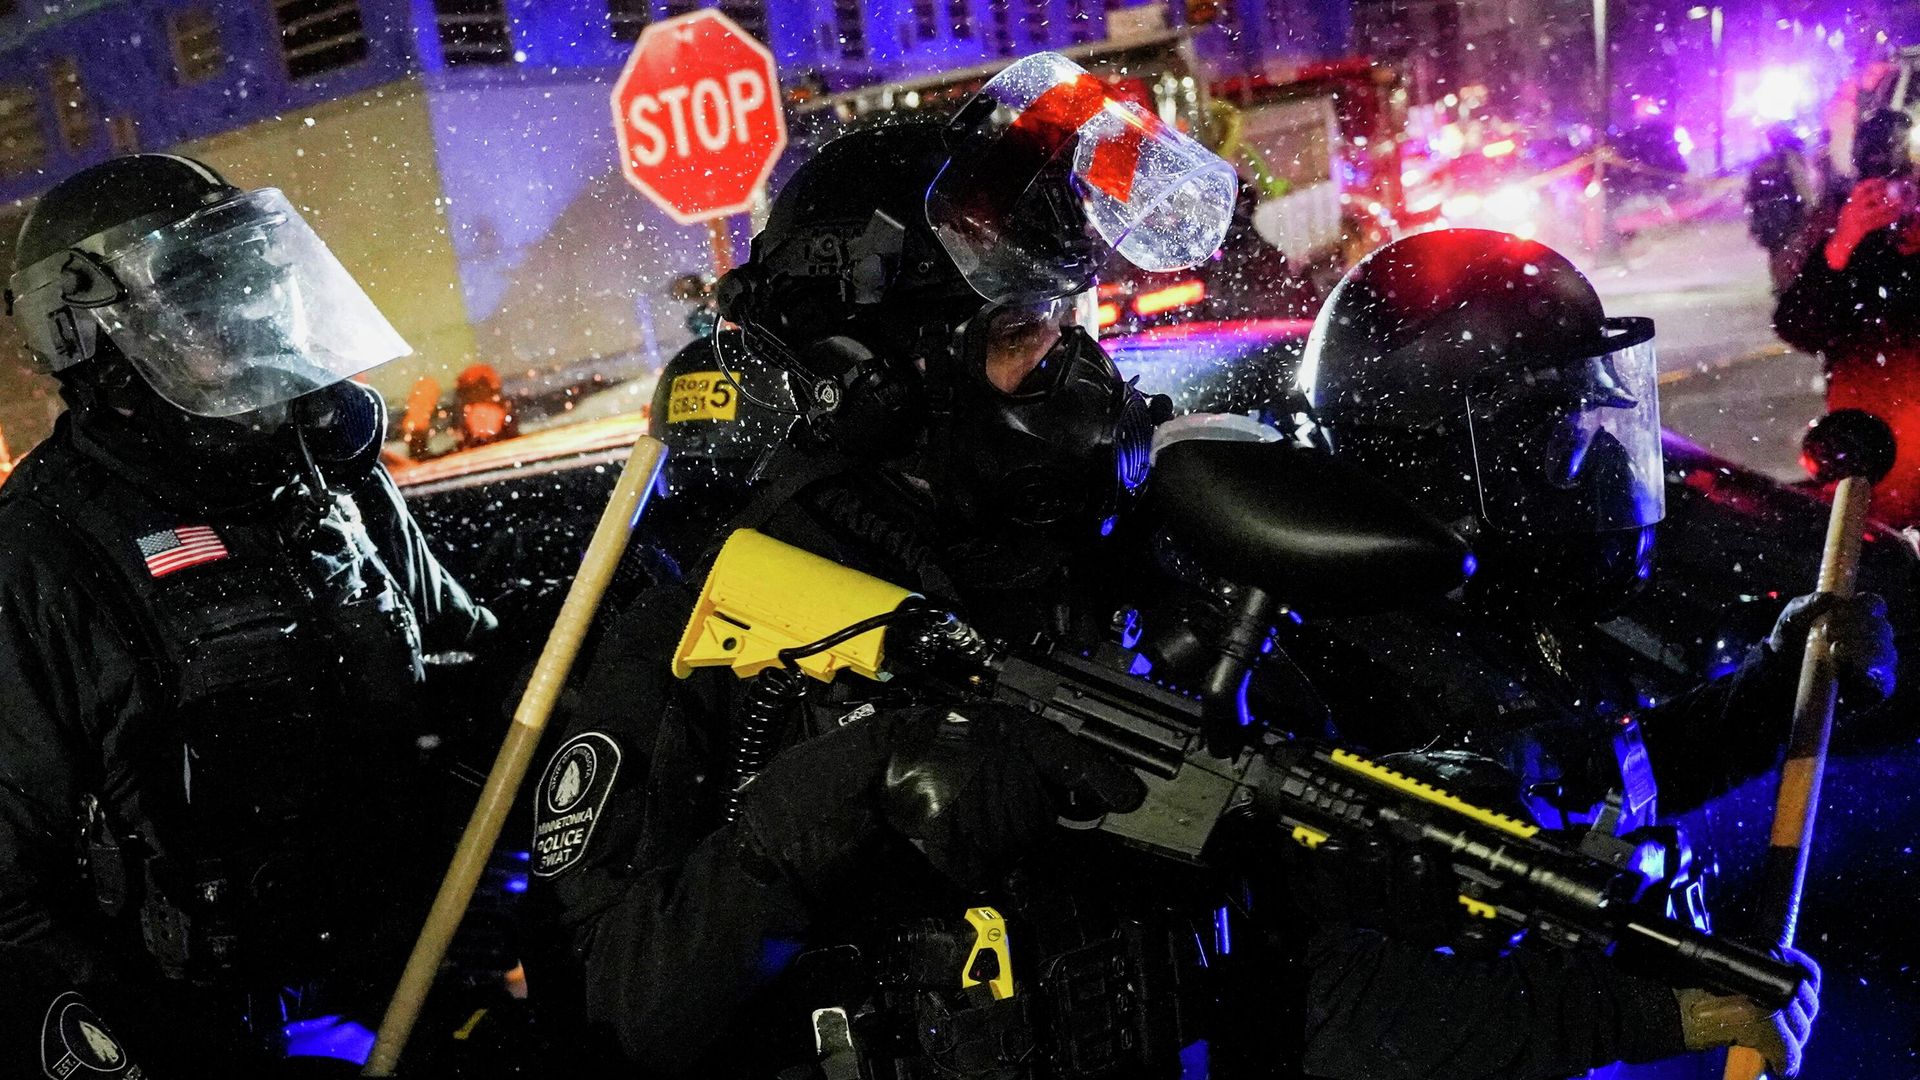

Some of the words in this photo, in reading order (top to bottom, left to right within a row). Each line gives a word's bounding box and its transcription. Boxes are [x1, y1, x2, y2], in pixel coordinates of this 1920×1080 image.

[628, 69, 765, 167] STOP
[710, 380, 731, 408] 5
[537, 807, 593, 834] MINNETONKA
[537, 828, 584, 854] POLICE
